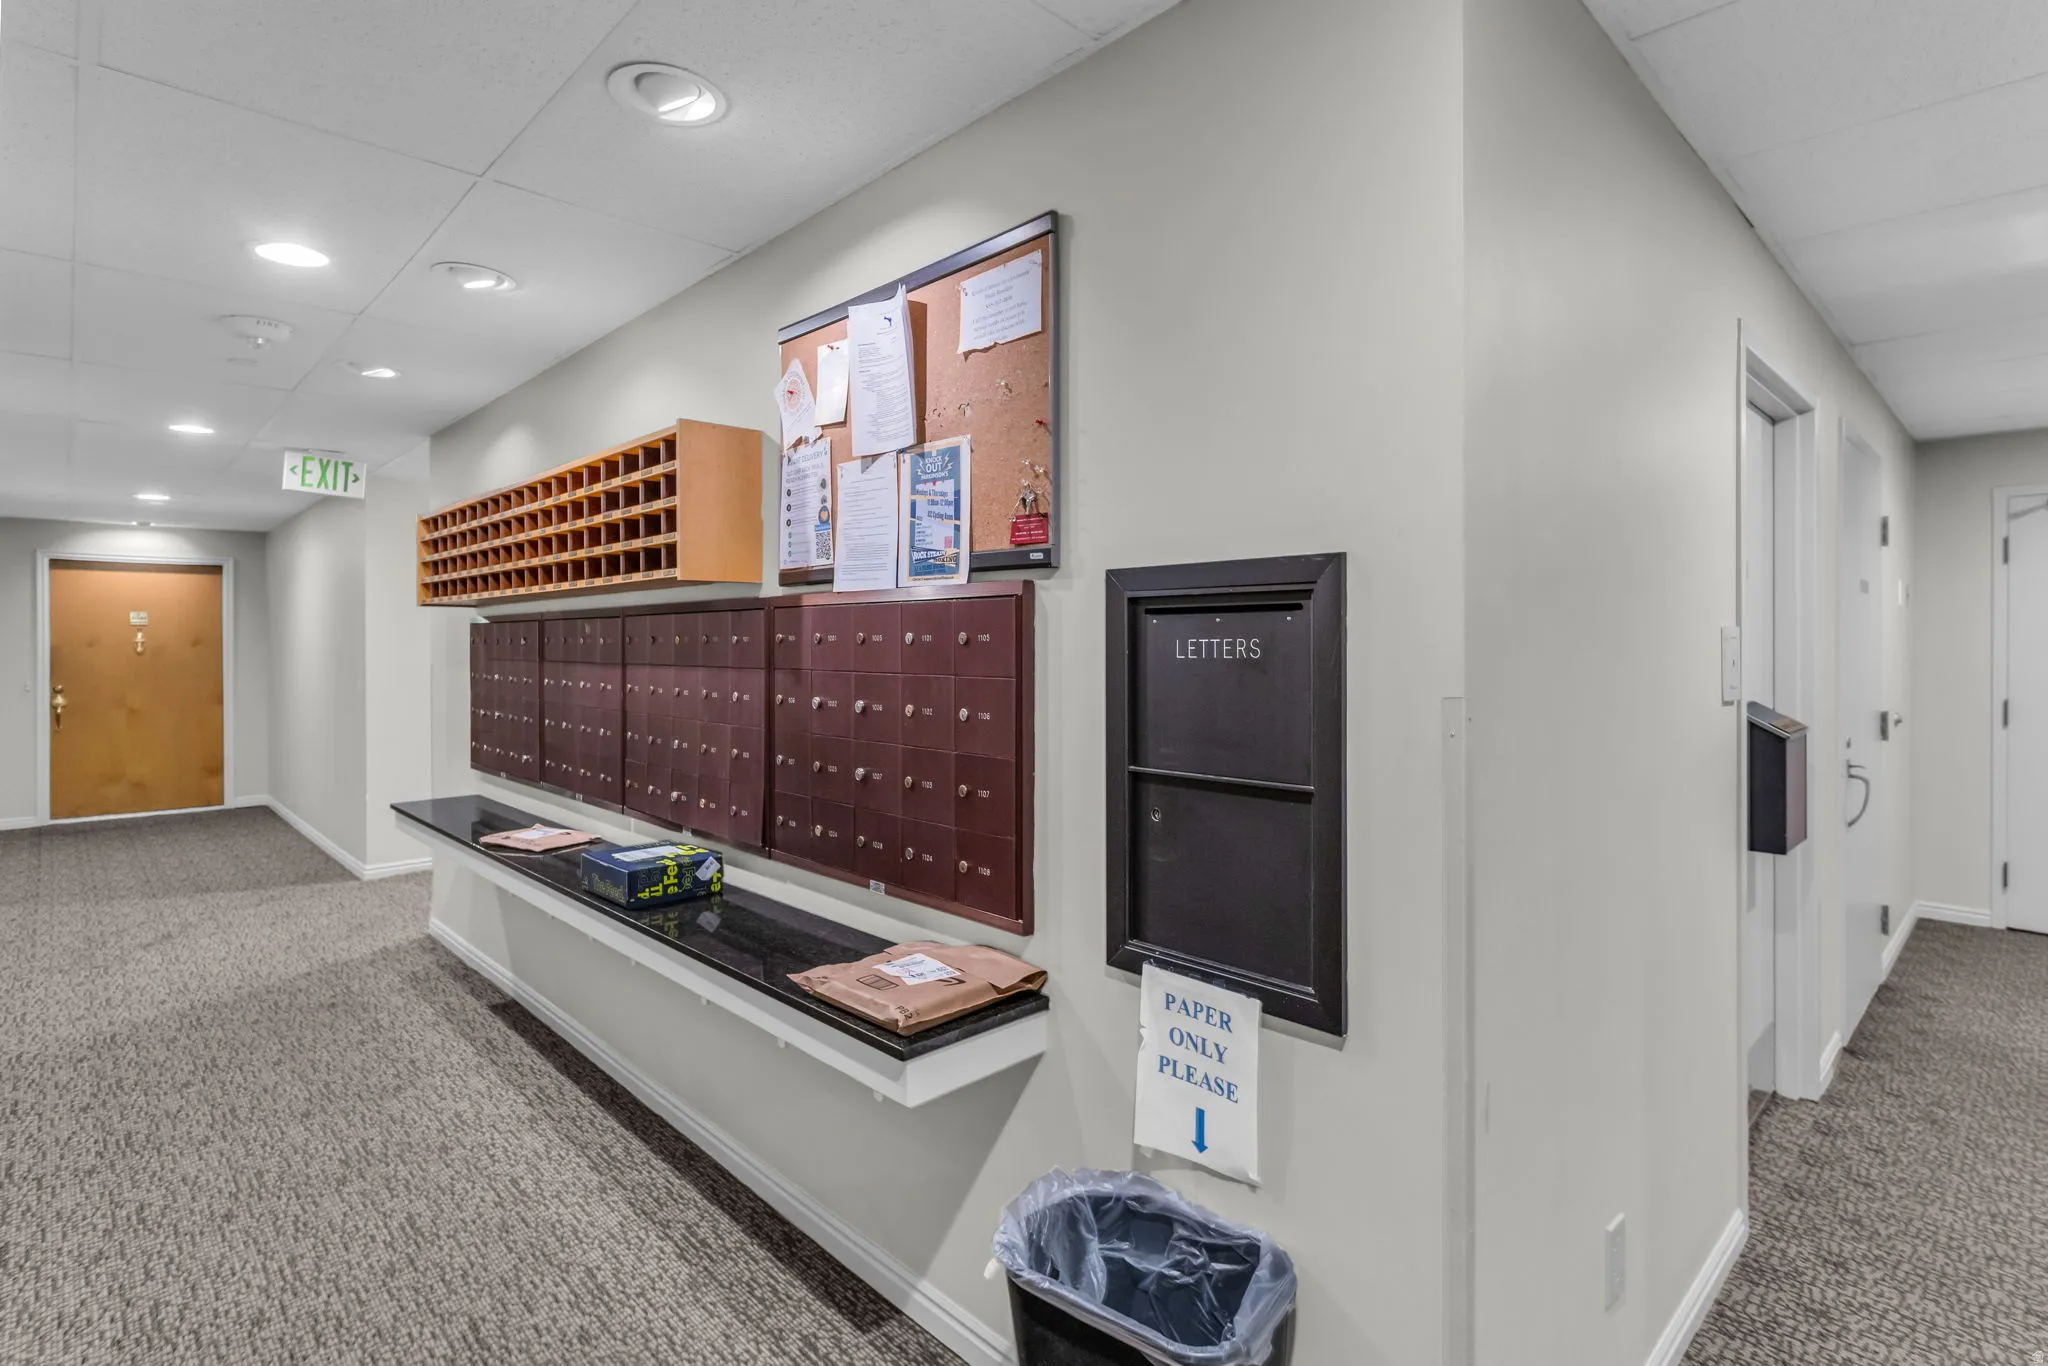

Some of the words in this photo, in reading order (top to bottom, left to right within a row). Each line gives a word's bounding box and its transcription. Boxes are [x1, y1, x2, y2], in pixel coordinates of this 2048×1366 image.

[925, 456, 942, 464] KNOCK
[926, 463, 942, 473] OUT
[301, 455, 354, 492] EXIT
[978, 634, 990, 642] 1105
[1176, 638, 1261, 658] LETTERS
[978, 712, 990, 720] 1106
[922, 780, 932, 789] 1103
[978, 790, 990, 798] 1107
[922, 854, 932, 862] 1104
[978, 866, 990, 876] 1108
[1164, 992, 1233, 1034] PAPER
[1169, 1027, 1228, 1064] ONLY
[1158, 1055, 1238, 1104] PLEASE
